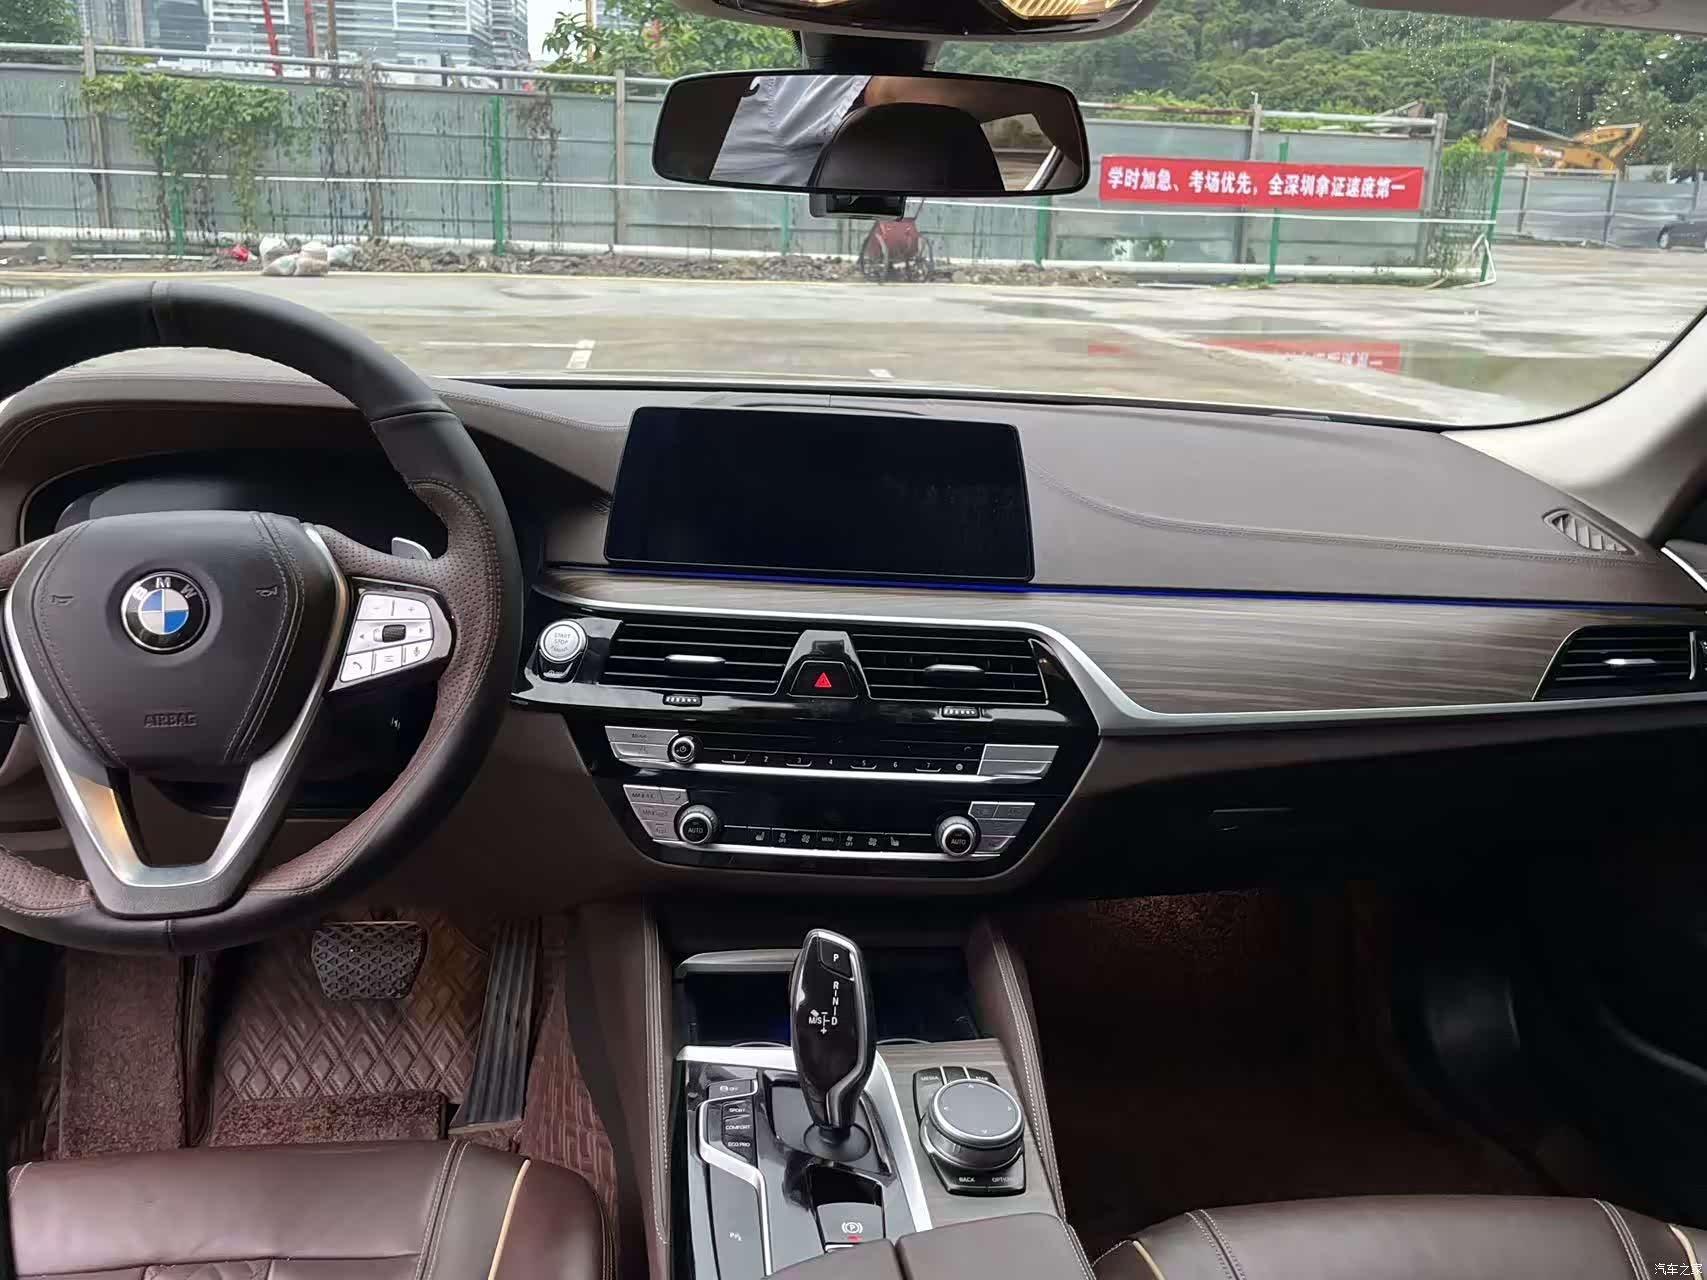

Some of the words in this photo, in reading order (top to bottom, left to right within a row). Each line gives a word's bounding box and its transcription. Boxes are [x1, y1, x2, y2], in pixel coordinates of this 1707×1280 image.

[132, 576, 197, 600] BMW
[833, 953, 839, 962] P
[833, 981, 839, 990] R
[832, 997, 839, 1006] N
[808, 1016, 822, 1025] M/S
[831, 1017, 838, 1026] D
